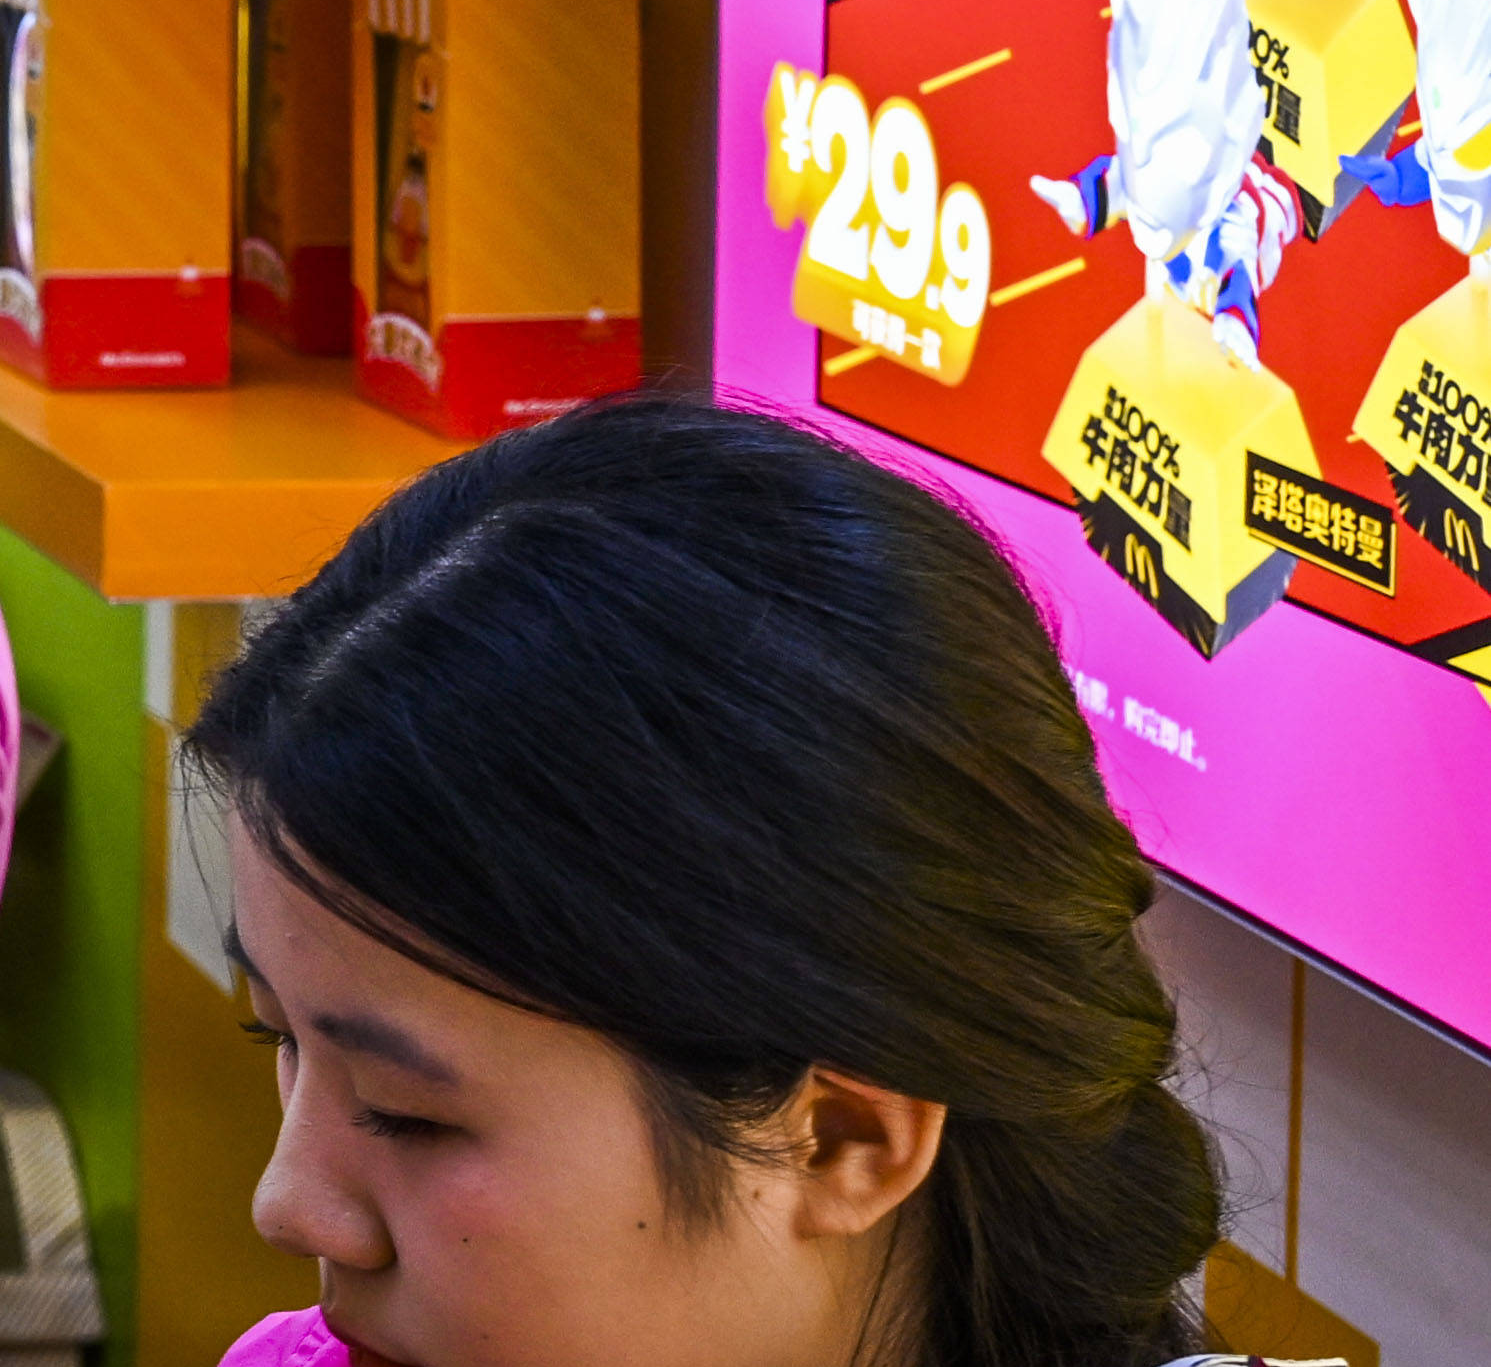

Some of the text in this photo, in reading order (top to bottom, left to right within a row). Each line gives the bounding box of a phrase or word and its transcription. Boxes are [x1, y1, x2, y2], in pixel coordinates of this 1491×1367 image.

[1081, 414, 1192, 552] 牛肉力量
[1252, 469, 1385, 570] 泽塔奥特曼
